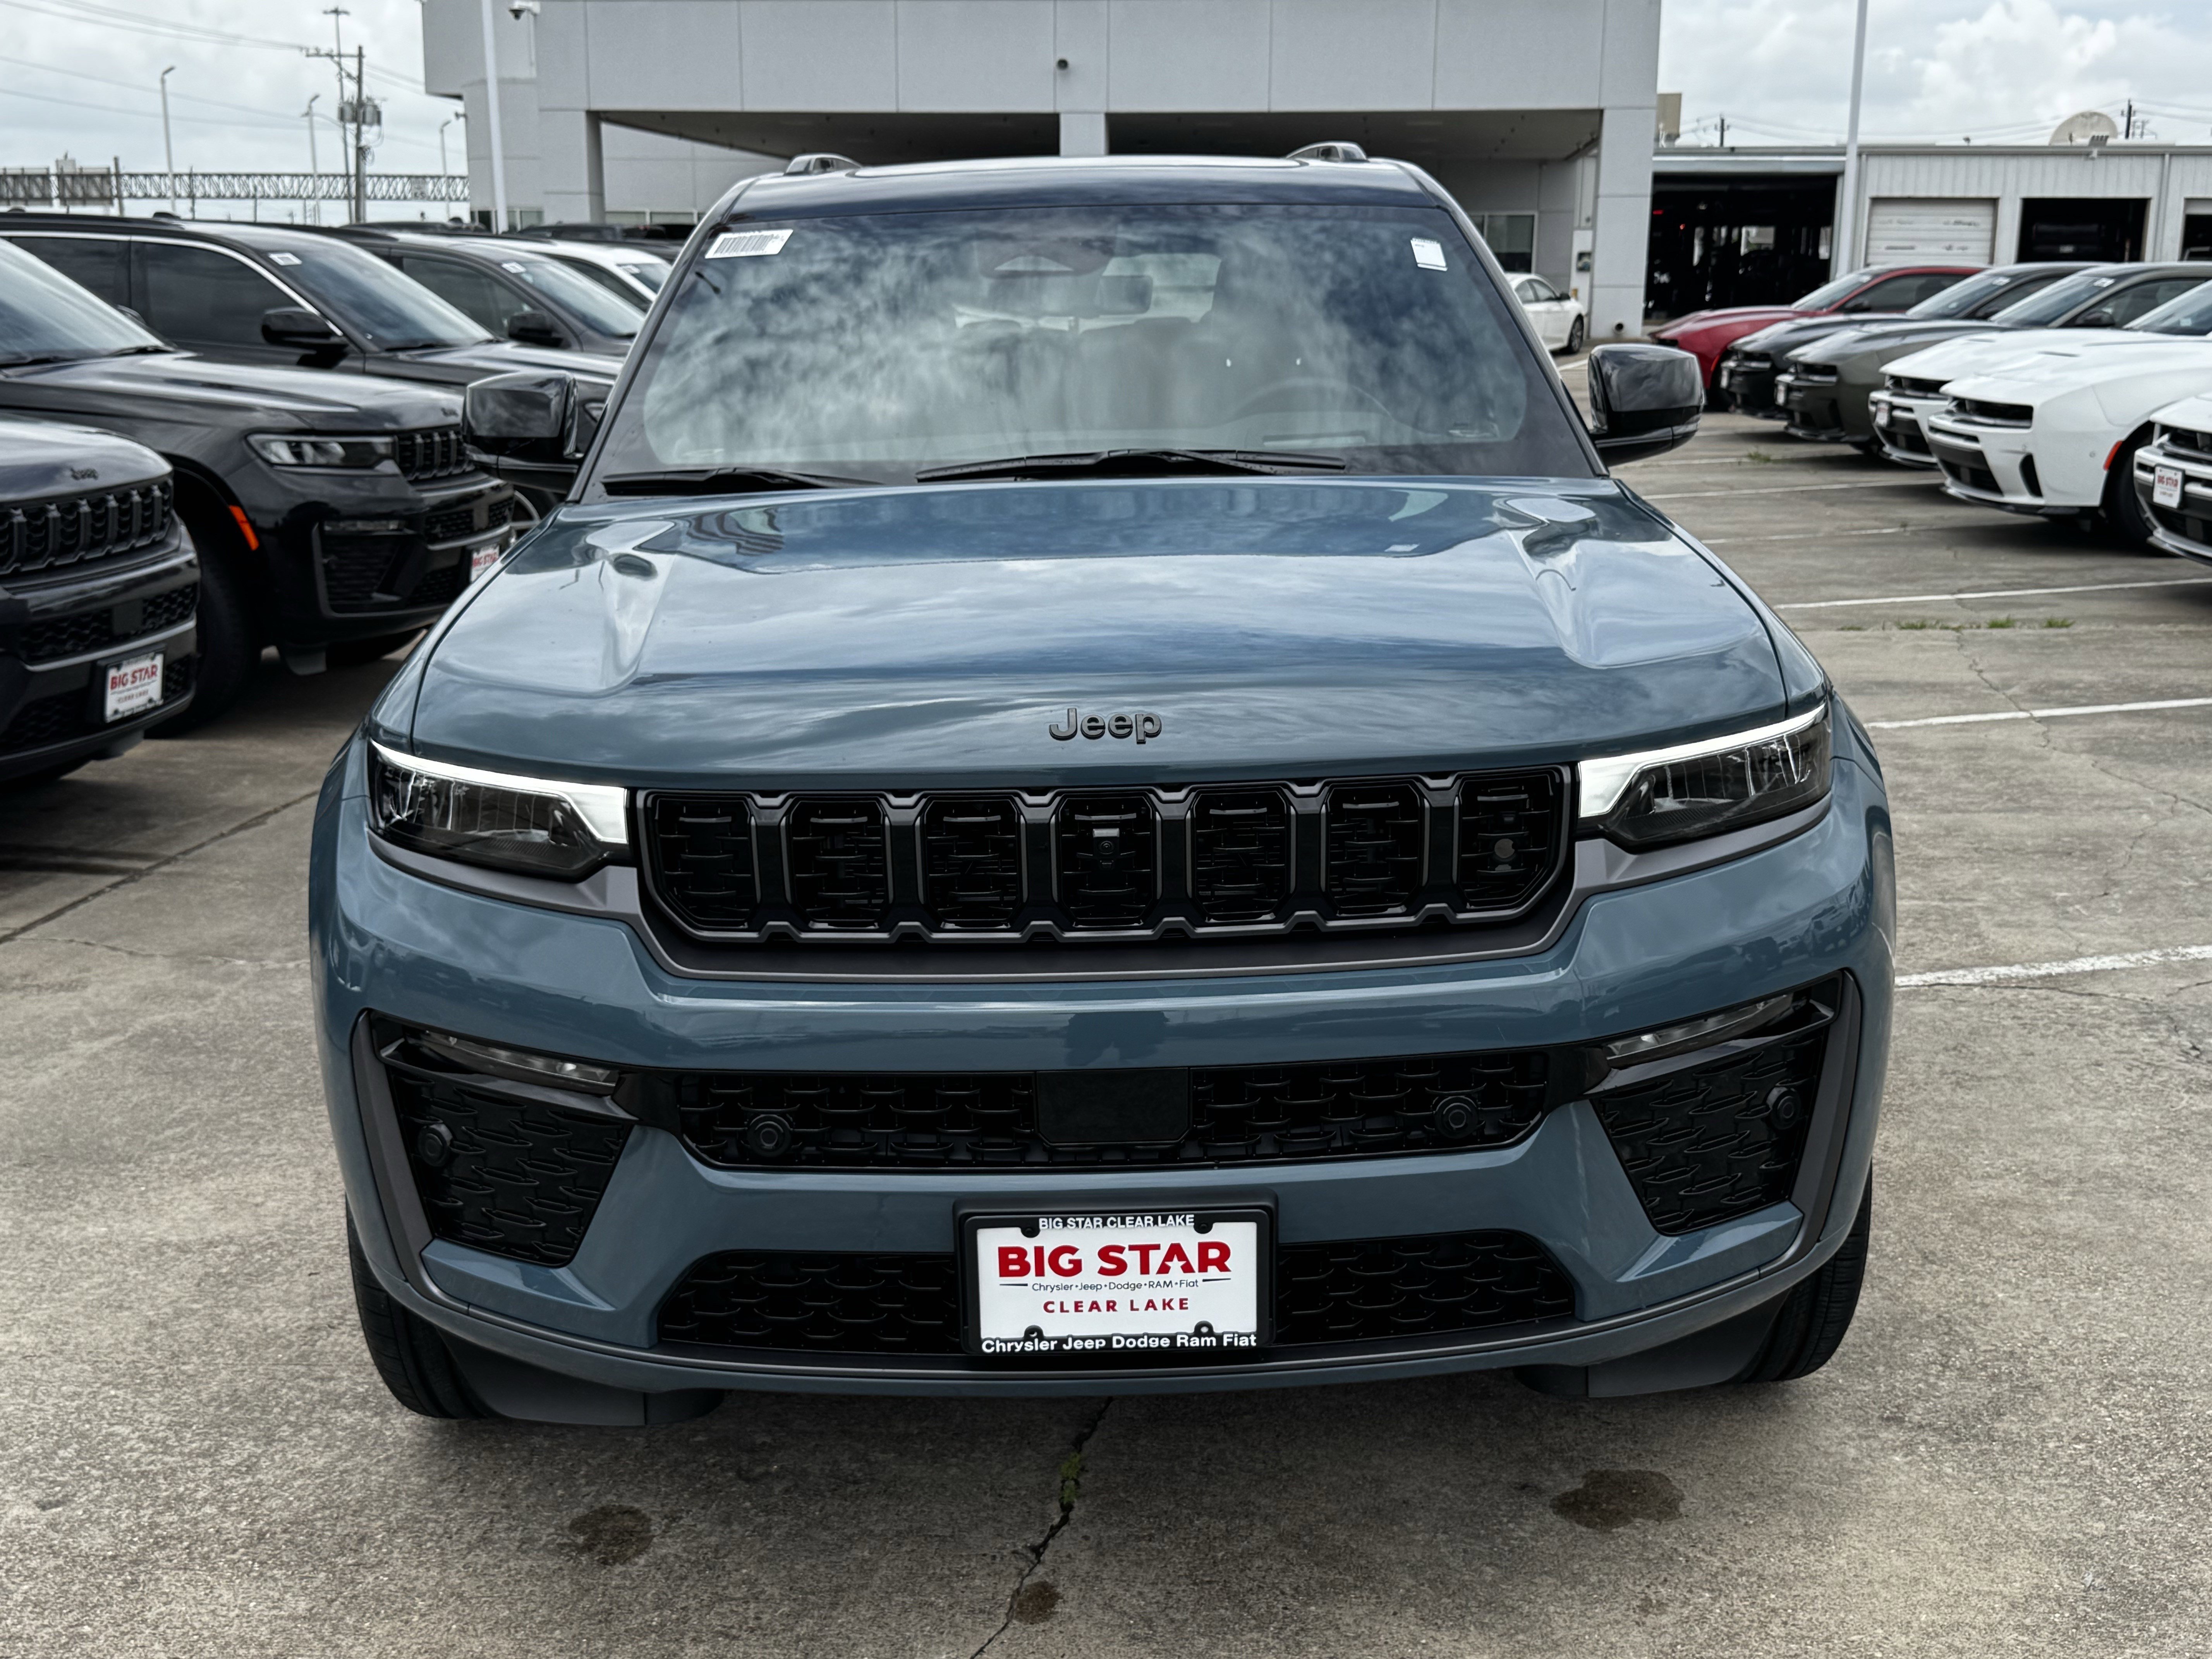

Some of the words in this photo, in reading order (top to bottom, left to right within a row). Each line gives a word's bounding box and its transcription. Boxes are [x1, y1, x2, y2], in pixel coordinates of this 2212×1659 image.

[111, 673, 129, 690] BIG
[131, 665, 158, 684] STAR
[1049, 708, 1162, 744] Jeep
[1039, 1217, 1063, 1229] BIG
[1067, 1217, 1103, 1229] STAR
[1106, 1216, 1154, 1228] CLEAR
[1158, 1214, 1195, 1226] LAKE
[998, 1245, 1083, 1278] BIG
[1097, 1241, 1231, 1277] STAR
[1032, 1283, 1073, 1293] Chrysler
[1109, 1281, 1142, 1291] Dodge
[1148, 1280, 1173, 1288] RAM
[1179, 1279, 1199, 1288] Fiat
[1043, 1300, 1118, 1313] CLEAR
[1130, 1298, 1189, 1311] LAKE
[982, 1338, 1058, 1353] Chrysler
[1063, 1337, 1106, 1352] Jeep
[1112, 1335, 1170, 1350] Dodge
[1176, 1334, 1216, 1347] Ram
[1223, 1334, 1257, 1346] Fiat
